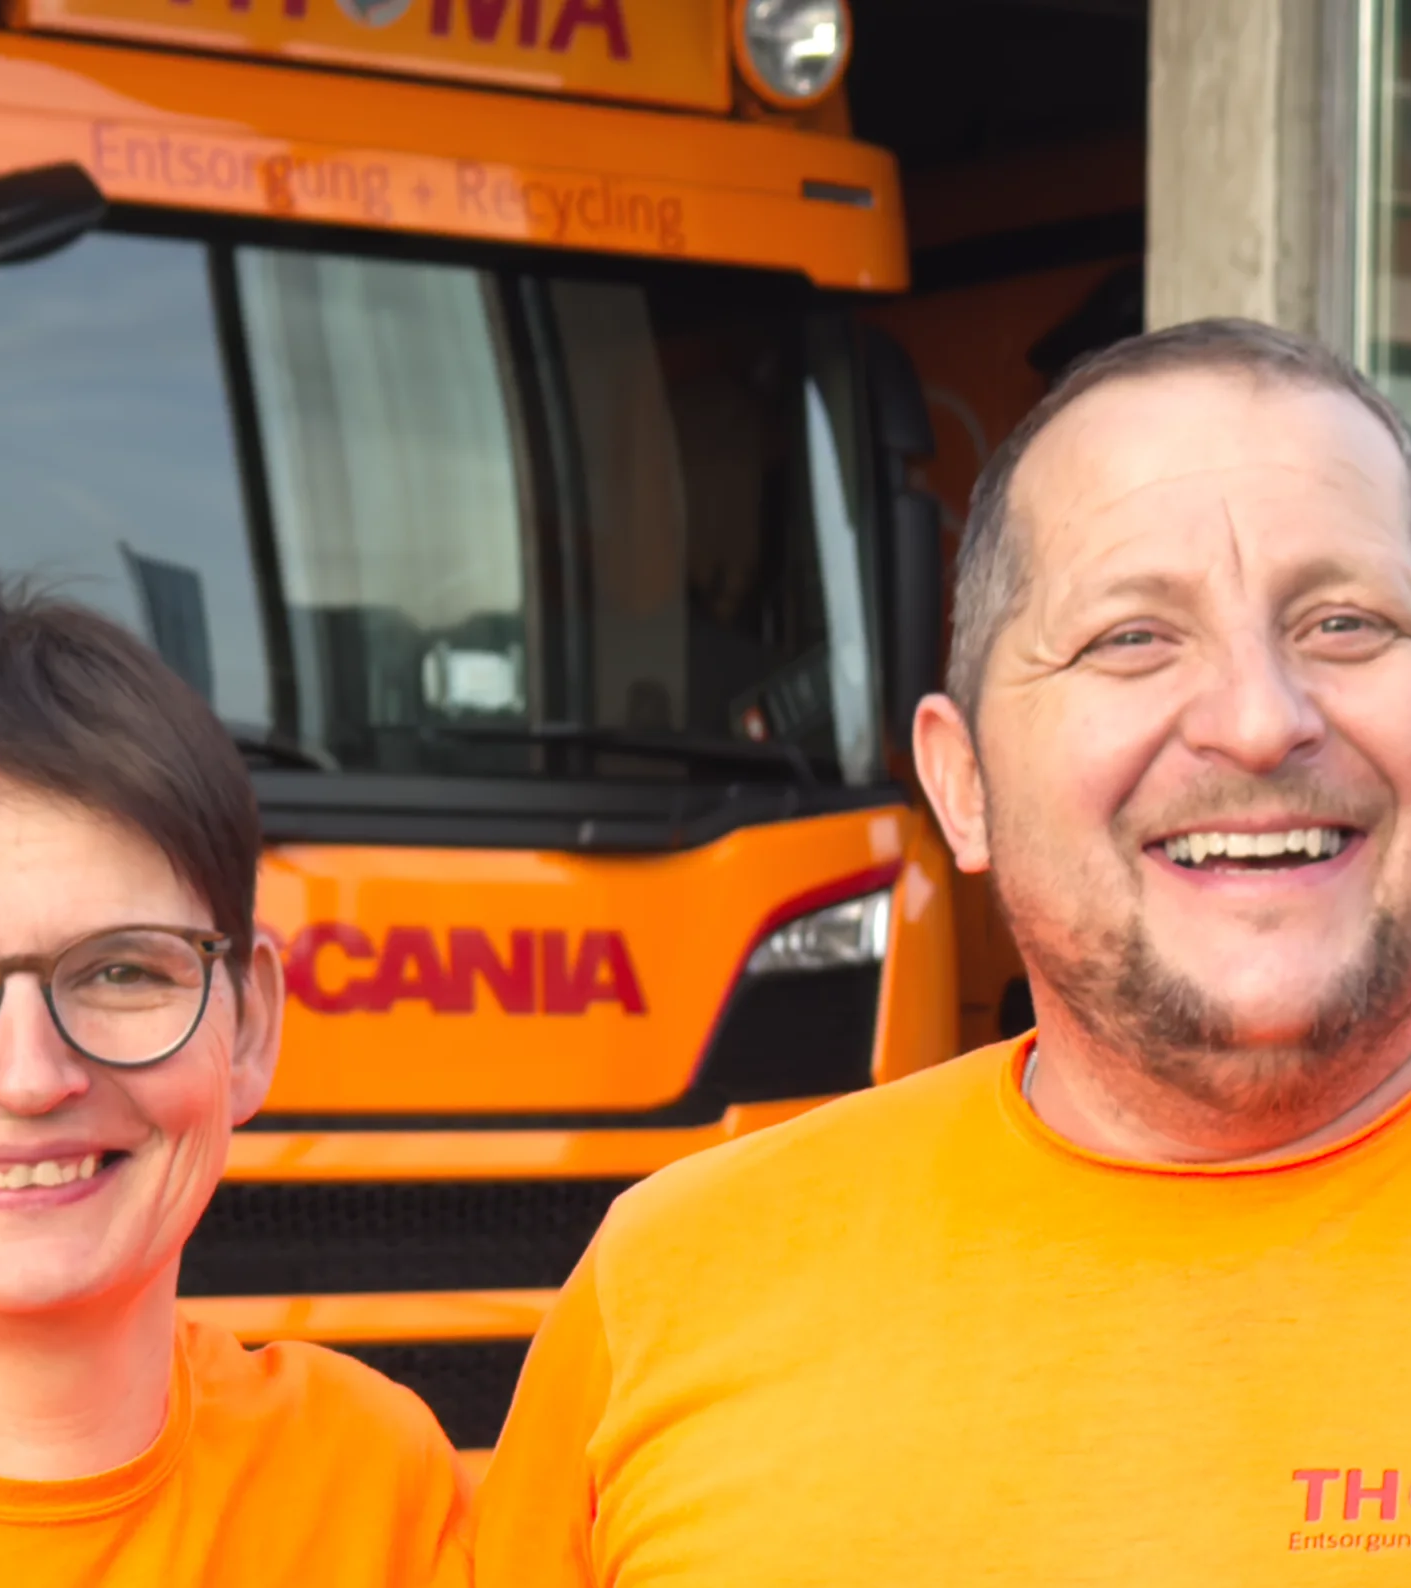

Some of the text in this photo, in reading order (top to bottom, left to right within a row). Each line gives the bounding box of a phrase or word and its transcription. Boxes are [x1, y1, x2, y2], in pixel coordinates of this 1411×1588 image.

[90, 119, 391, 221] Entsorgung
[454, 158, 683, 249] Recycling
[255, 921, 649, 1018] CANIA
